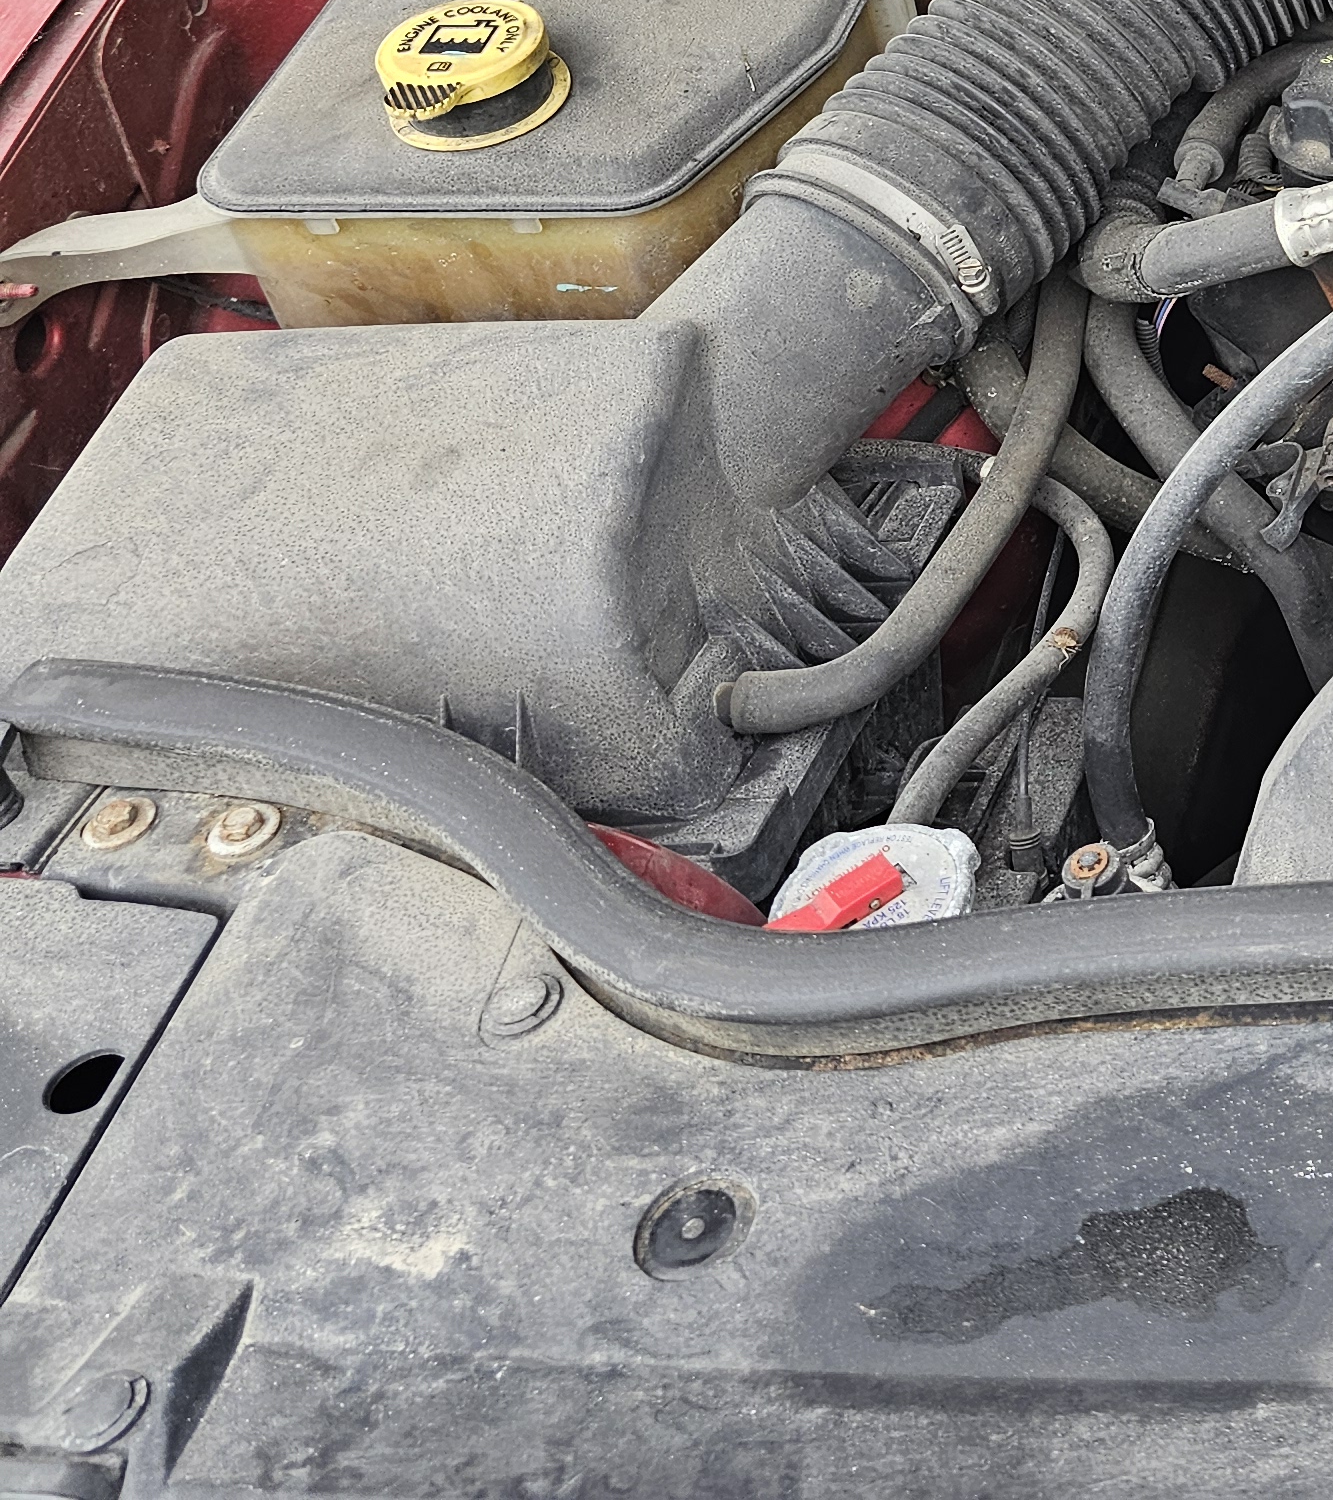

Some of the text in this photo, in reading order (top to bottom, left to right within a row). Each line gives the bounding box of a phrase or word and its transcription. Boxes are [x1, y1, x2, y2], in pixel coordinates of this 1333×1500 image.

[396, 5, 520, 53] ENGINE COOLANT ONLY
[829, 843, 852, 862] WHEN
[851, 835, 885, 851] REPLACE
[862, 899, 906, 929] 125 KPA
[898, 908, 911, 920] 18
[923, 895, 948, 921] LEVE
